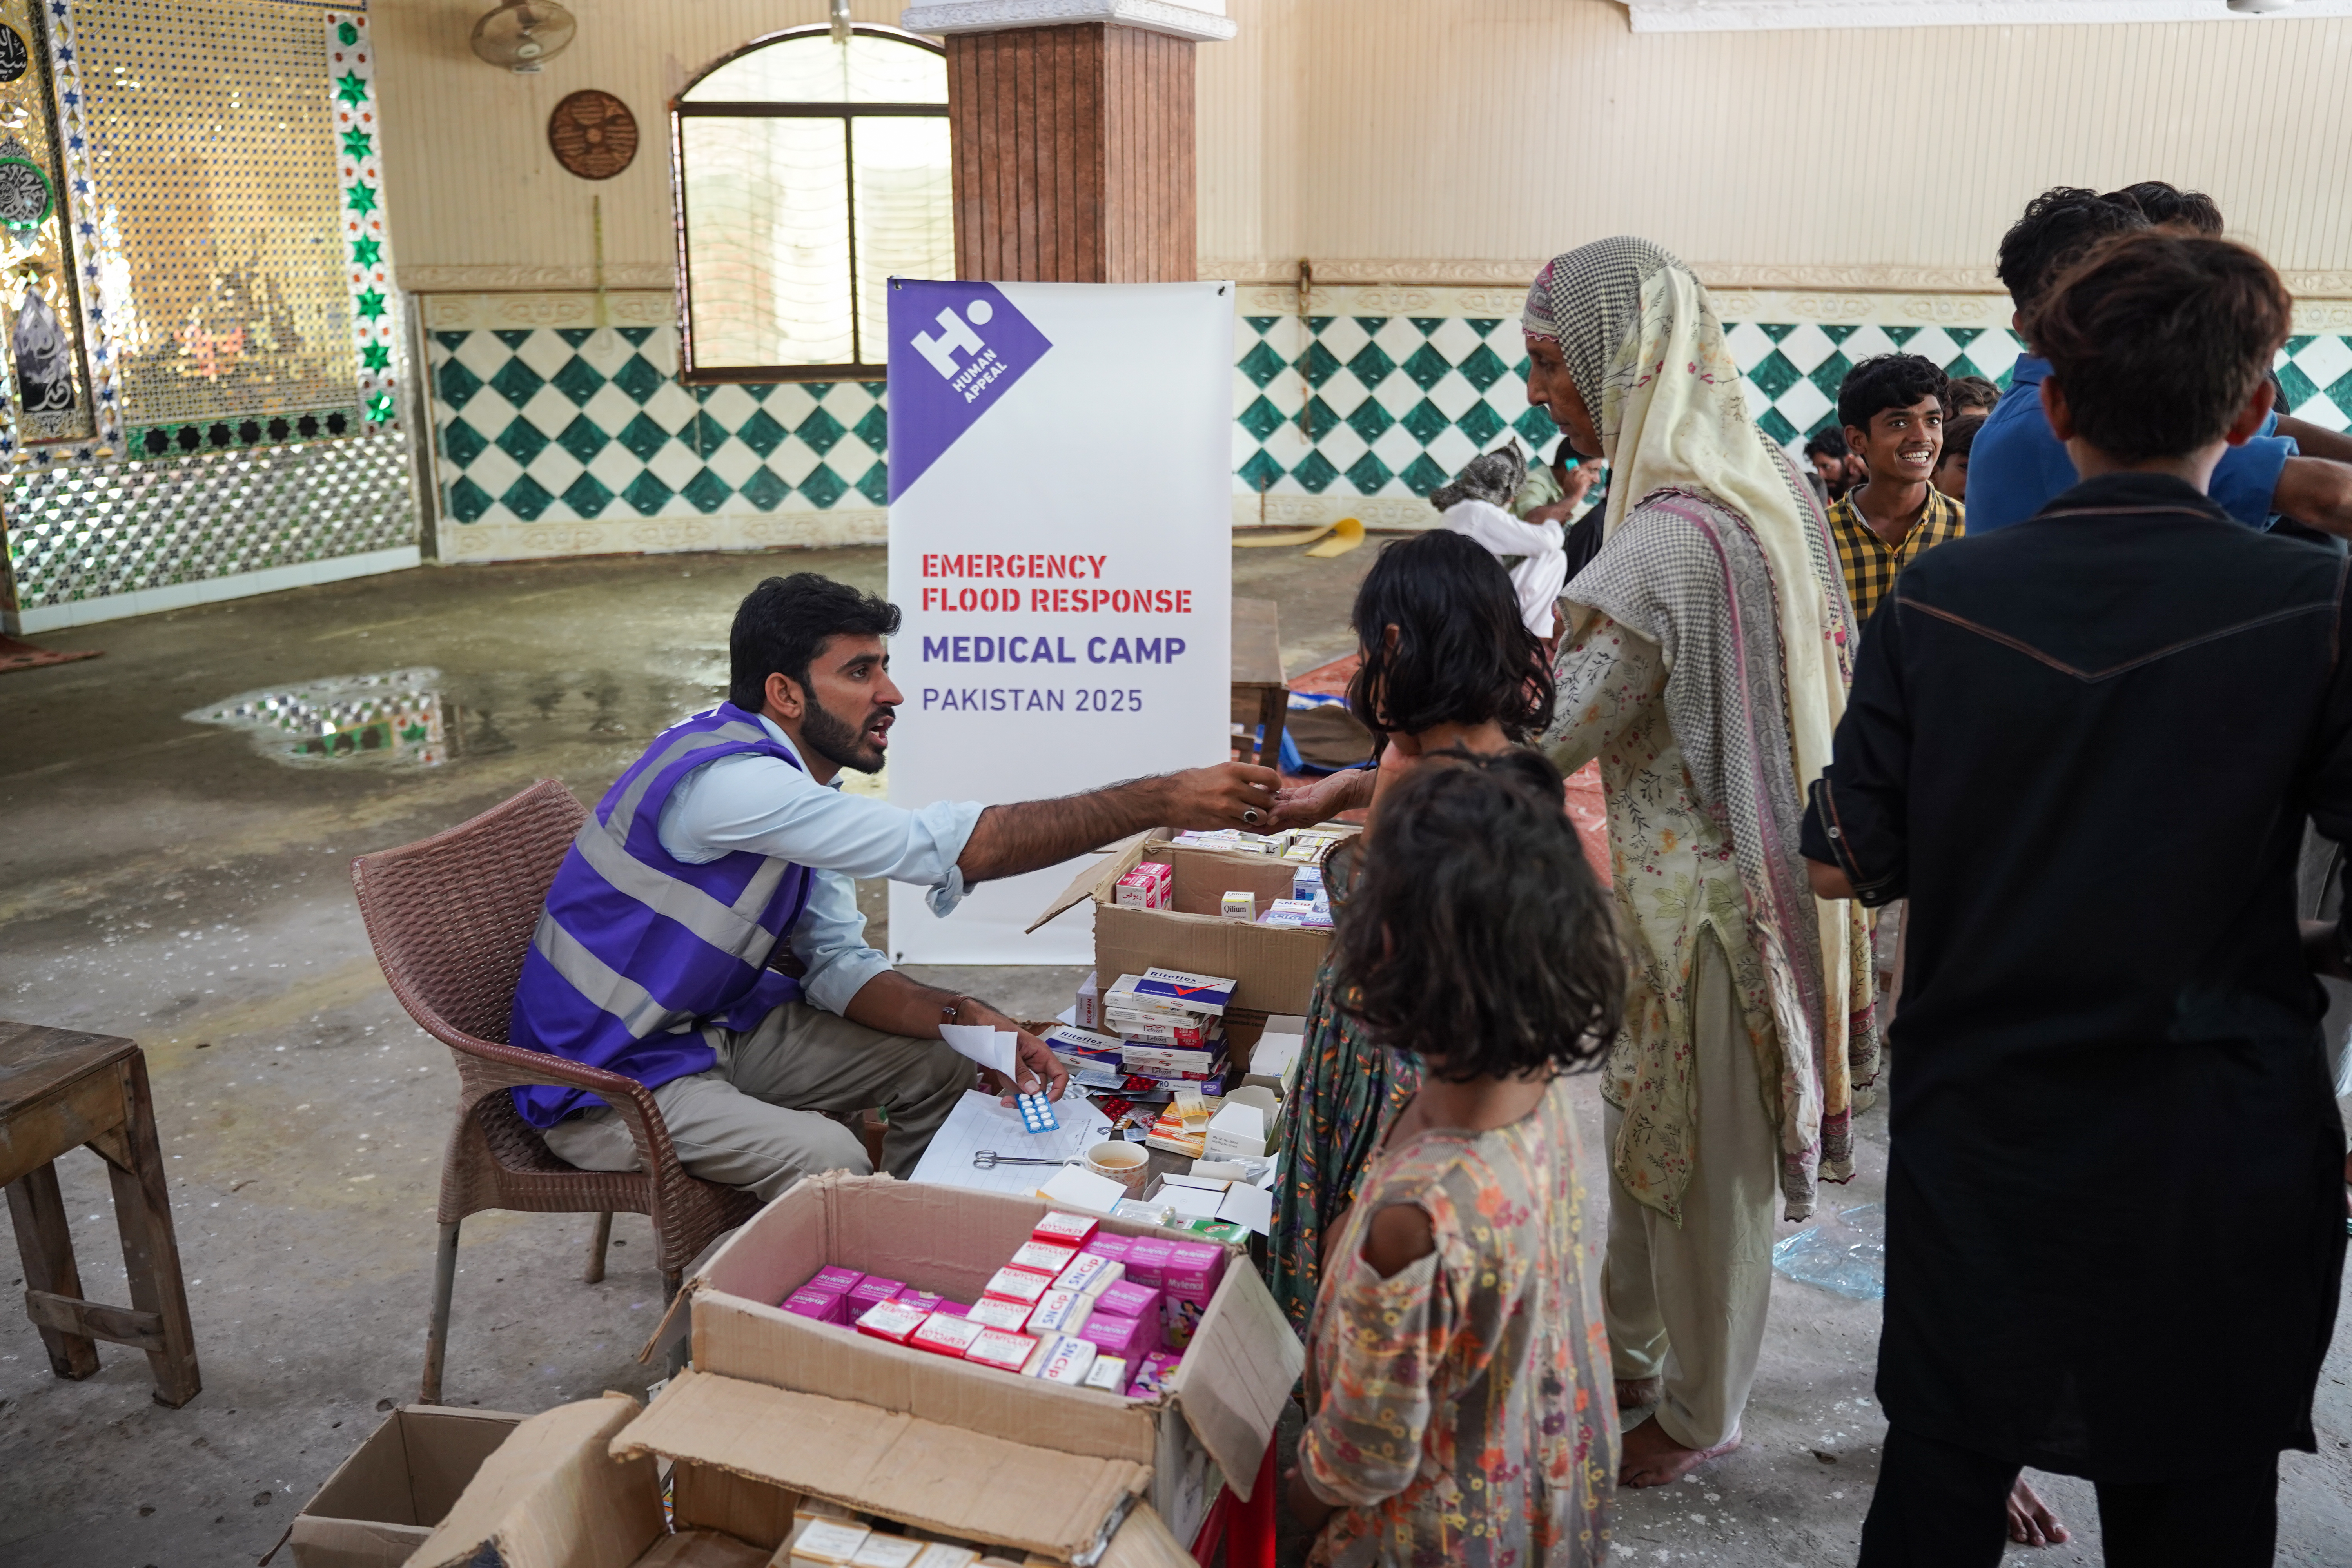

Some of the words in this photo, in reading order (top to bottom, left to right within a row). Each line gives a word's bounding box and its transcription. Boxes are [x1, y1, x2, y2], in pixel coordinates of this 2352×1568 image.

[952, 348, 997, 392] HUMAN
[964, 361, 1008, 404] APPEAL
[922, 554, 1106, 579] EMERGENCY
[922, 588, 1020, 612] FLOOD
[1031, 588, 1191, 613] RESPONSE
[924, 636, 1075, 663] MEDICAL
[1088, 637, 1185, 663] CAMP
[924, 689, 1063, 711] PAKISTAN
[1076, 690, 1142, 711] 2025
[1224, 905, 1246, 914] Qilium
[1150, 972, 1197, 982] Riteflox
[1060, 1032, 1103, 1045] Riteflox
[1040, 1223, 1084, 1235] KEMYCLOX
[1026, 1244, 1071, 1256] KEMYCLOX
[818, 1274, 853, 1285] Mylenol
[1002, 1270, 1047, 1283] KEMYCLOX
[862, 1283, 897, 1294] Mylenol
[1167, 1279, 1204, 1290] Mylenol
[792, 1295, 828, 1305] Mylenol
[900, 1298, 933, 1308] Mylenol
[981, 1300, 1027, 1314] KEMYCLOX
[920, 1328, 969, 1347] KEMYCLOX
[983, 1332, 1031, 1347] KEMYCLOX
